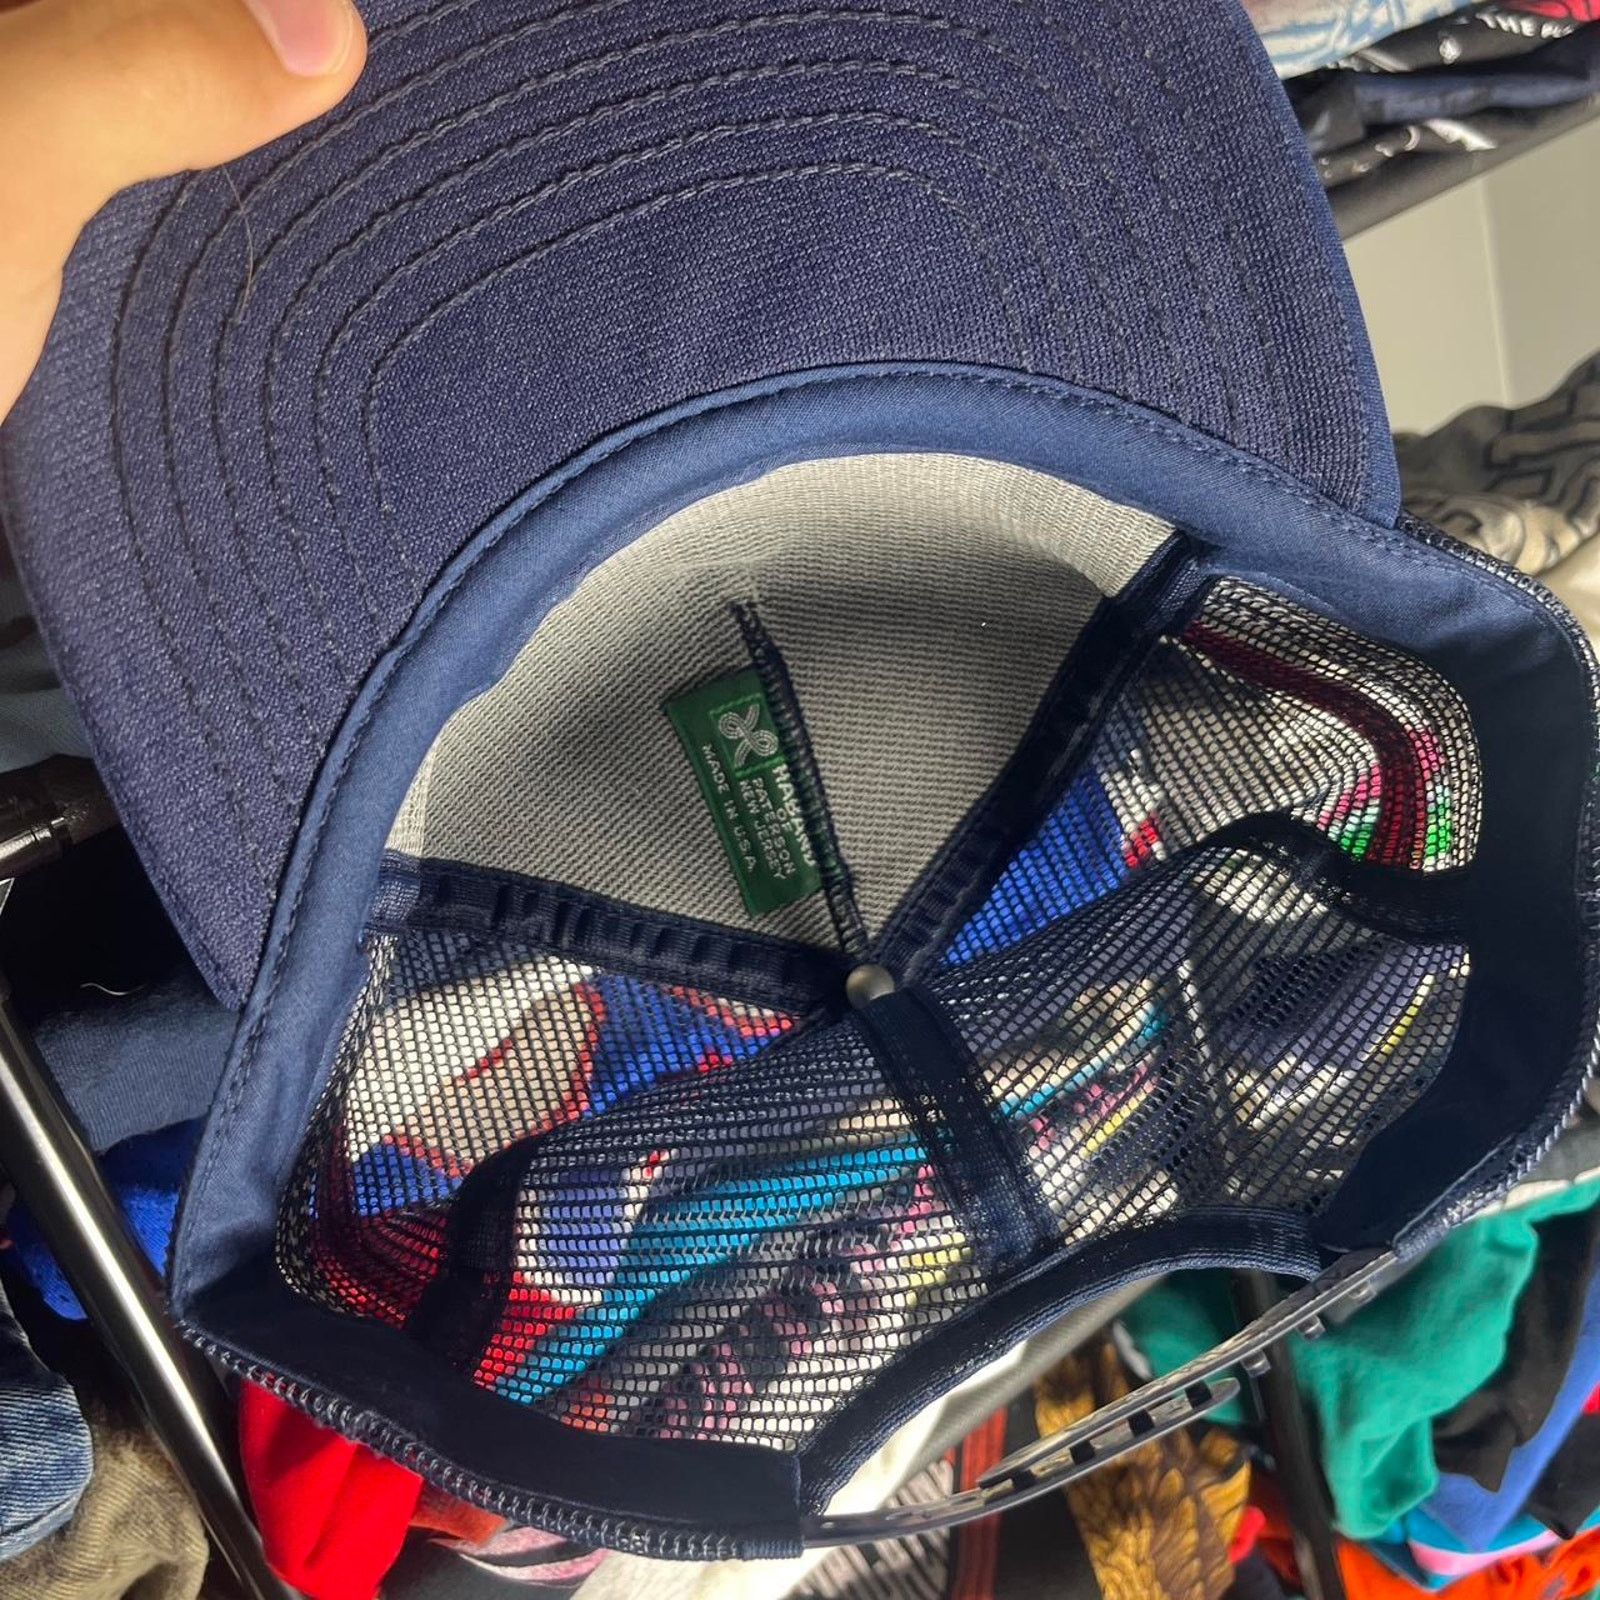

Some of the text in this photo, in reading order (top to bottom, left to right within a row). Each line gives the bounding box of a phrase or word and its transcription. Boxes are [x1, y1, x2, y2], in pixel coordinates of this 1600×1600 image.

[702, 744, 730, 795] MADE
[724, 799, 739, 820] IN
[776, 807, 793, 833] OF
[739, 780, 786, 880] NEW JERSEY
[752, 777, 796, 875] PATERSON
